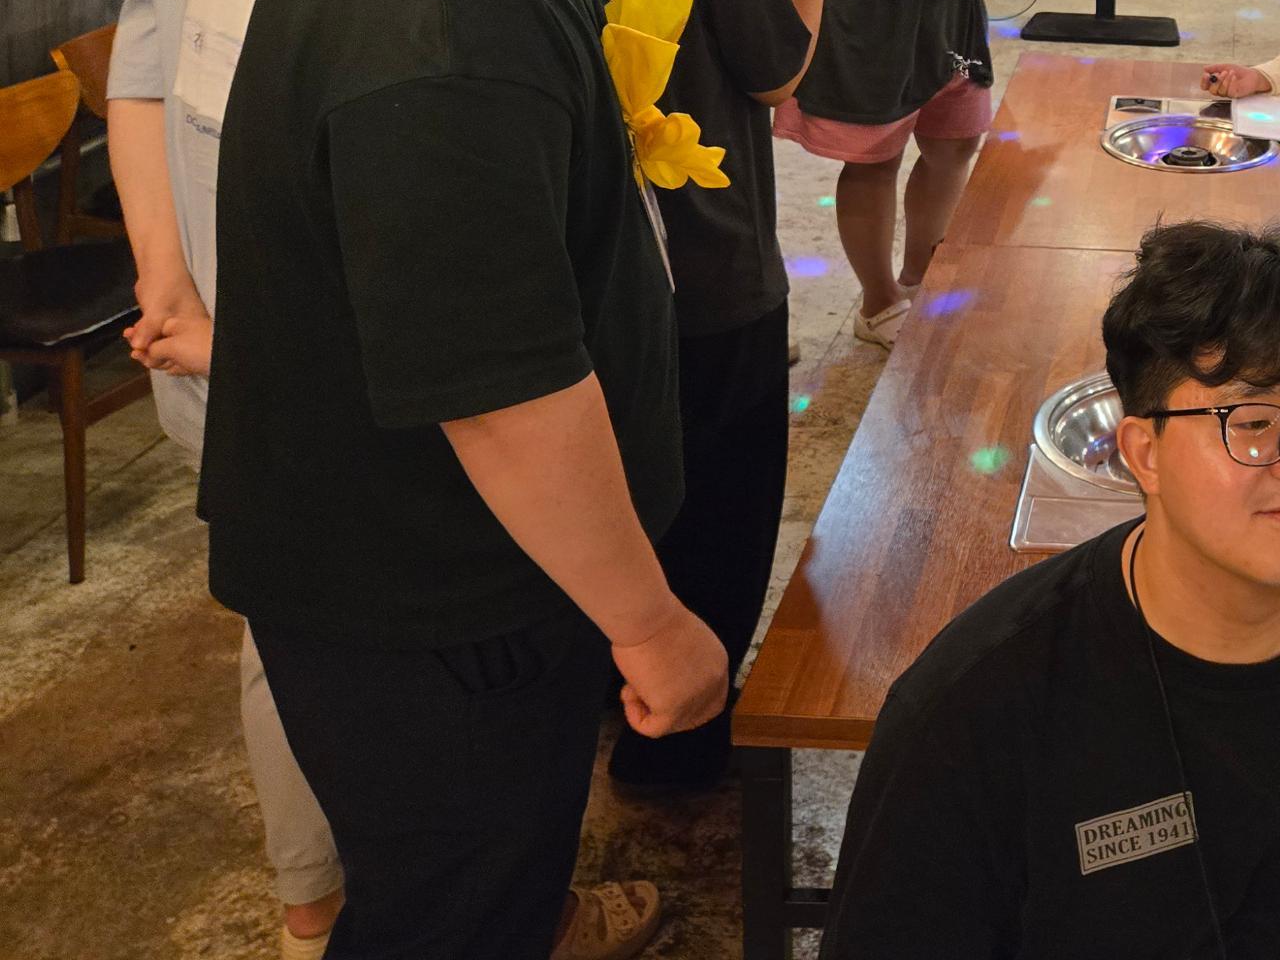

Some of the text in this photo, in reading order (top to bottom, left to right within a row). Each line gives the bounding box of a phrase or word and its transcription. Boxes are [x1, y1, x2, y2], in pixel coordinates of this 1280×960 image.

[1083, 801, 1188, 845] DREAMING
[1086, 821, 1190, 864] SINCE 1941
